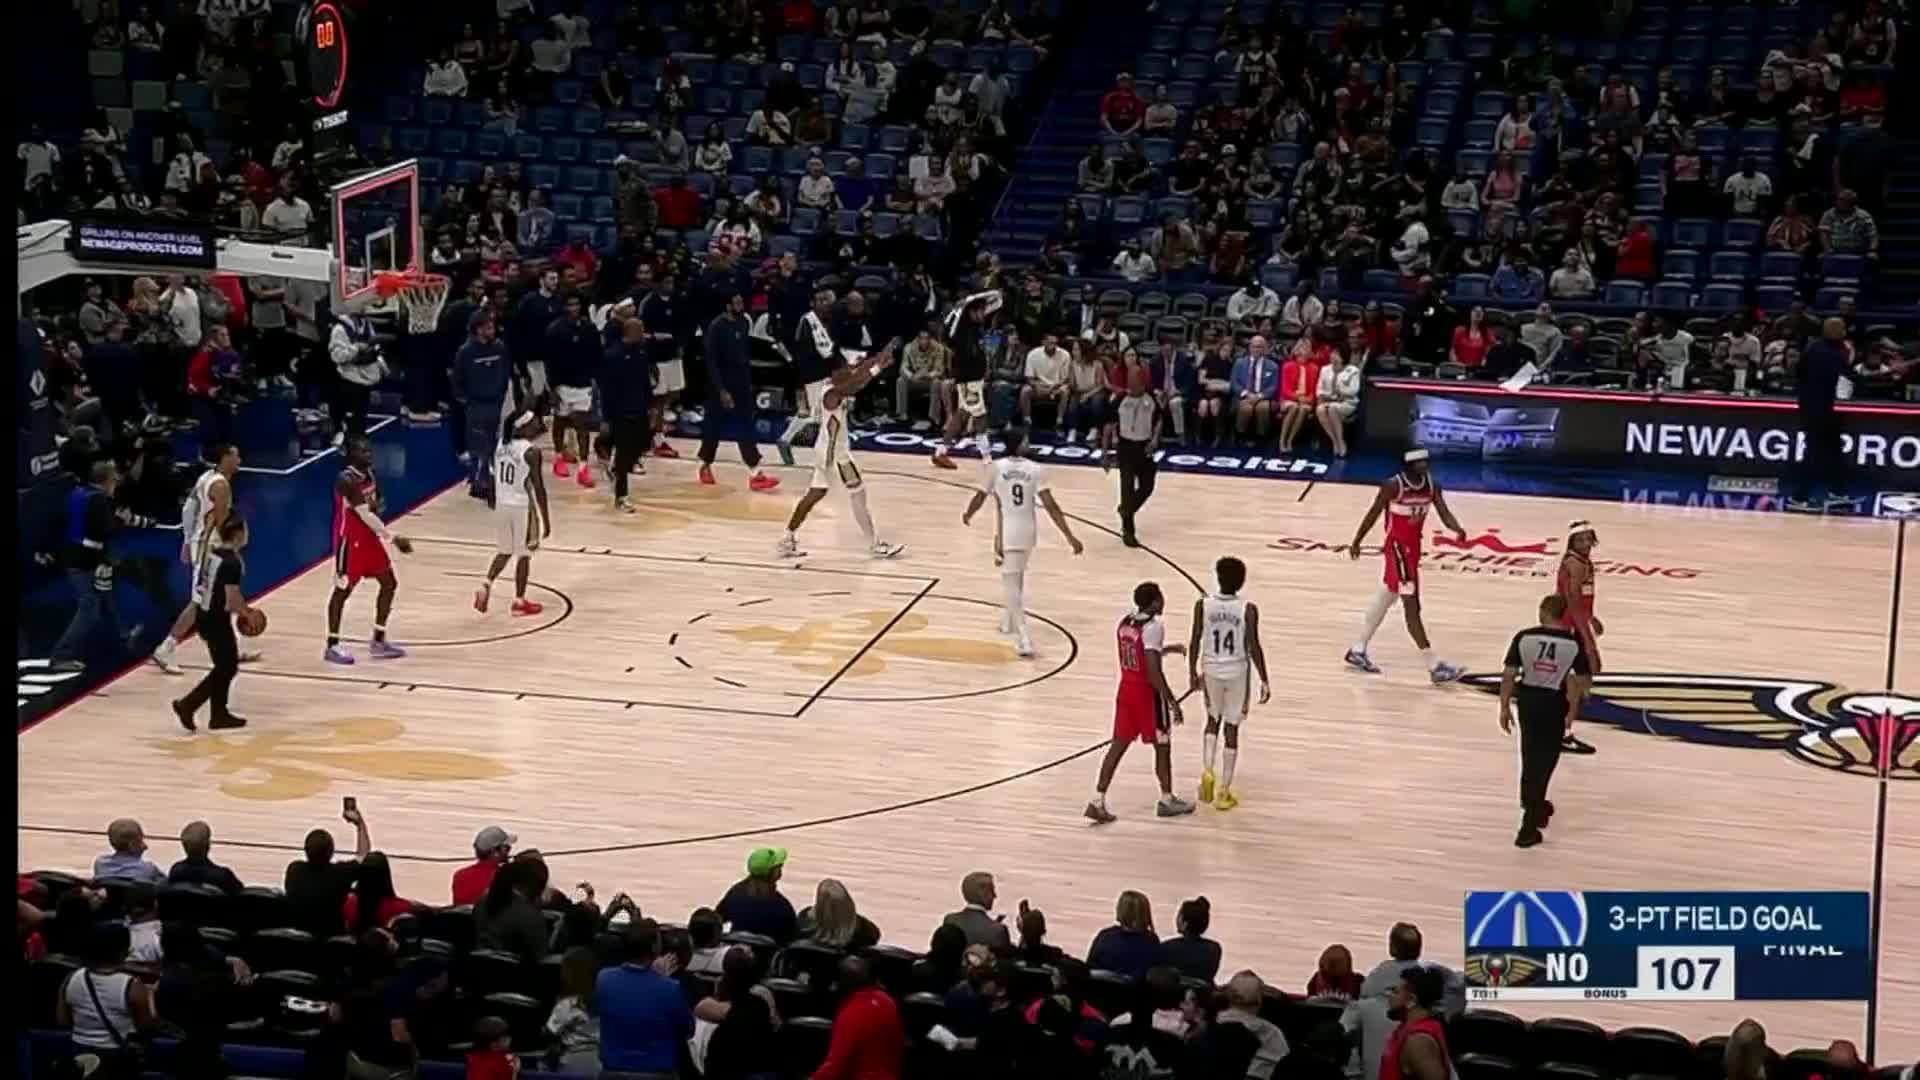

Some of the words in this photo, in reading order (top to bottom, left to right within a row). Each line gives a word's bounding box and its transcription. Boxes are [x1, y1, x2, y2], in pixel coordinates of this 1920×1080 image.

[80, 227, 119, 238] GRILLING
[121, 231, 134, 240] ON
[135, 231, 175, 242] ANOTHER
[177, 234, 202, 243] LEVEL
[80, 238, 204, 256] NEWAGEPRODUCTS.COM
[500, 461, 515, 485] 10
[1011, 483, 1025, 506] 9
[1266, 537, 1543, 566] SMOTHIE
[1212, 628, 1235, 656] 14
[1538, 641, 1557, 661] 74
